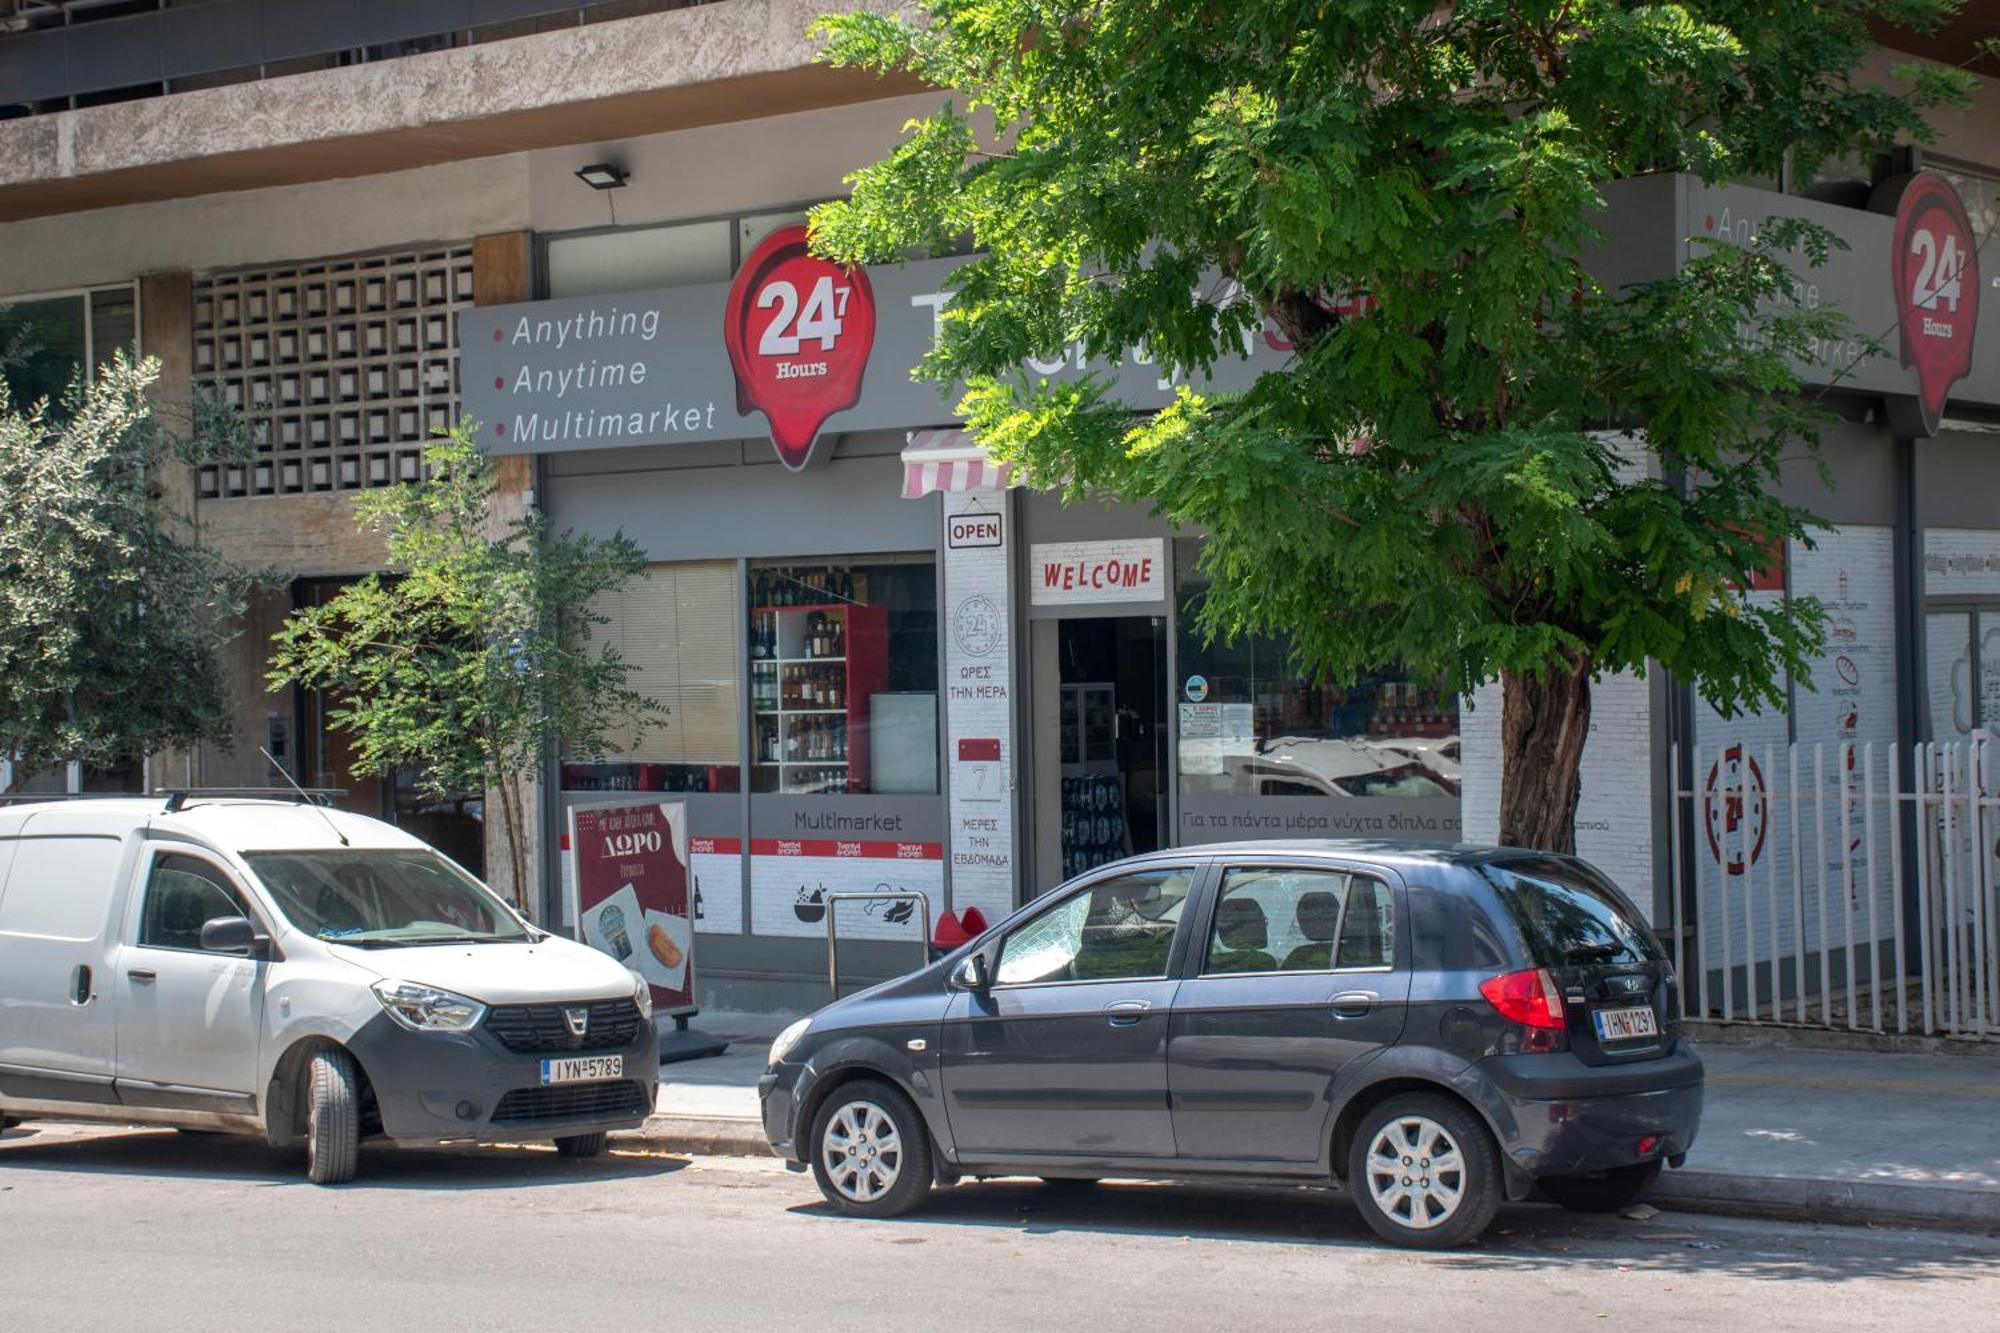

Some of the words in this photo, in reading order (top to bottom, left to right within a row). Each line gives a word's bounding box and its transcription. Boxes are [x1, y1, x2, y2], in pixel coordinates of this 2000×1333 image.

[511, 307, 660, 349] Anything
[512, 359, 647, 398] Anytime
[775, 361, 828, 379] Hours
[512, 402, 716, 443] Multimarket
[952, 524, 998, 540] OPEN
[1044, 558, 1152, 591] WELCOME
[960, 665, 992, 679] ΩΡΕΣ
[950, 686, 973, 699] ΤΗΝ
[976, 685, 1008, 699] ΜΕΡΑ
[794, 812, 904, 831] Multimarket
[962, 819, 999, 832] ΜΕΡΕΣ
[1183, 812, 1204, 828] Για
[1210, 815, 1228, 828] τα
[1233, 811, 1281, 828] πάντα
[1286, 812, 1328, 832] μέρα
[1333, 812, 1383, 833] νύχτα
[1388, 812, 1437, 831] δίπλα
[600, 831, 661, 858] ΔΩΡΟ
[968, 836, 990, 849] ΤΗΝ
[953, 853, 1009, 866] ΕΒΔΟΜΑΔΑ
